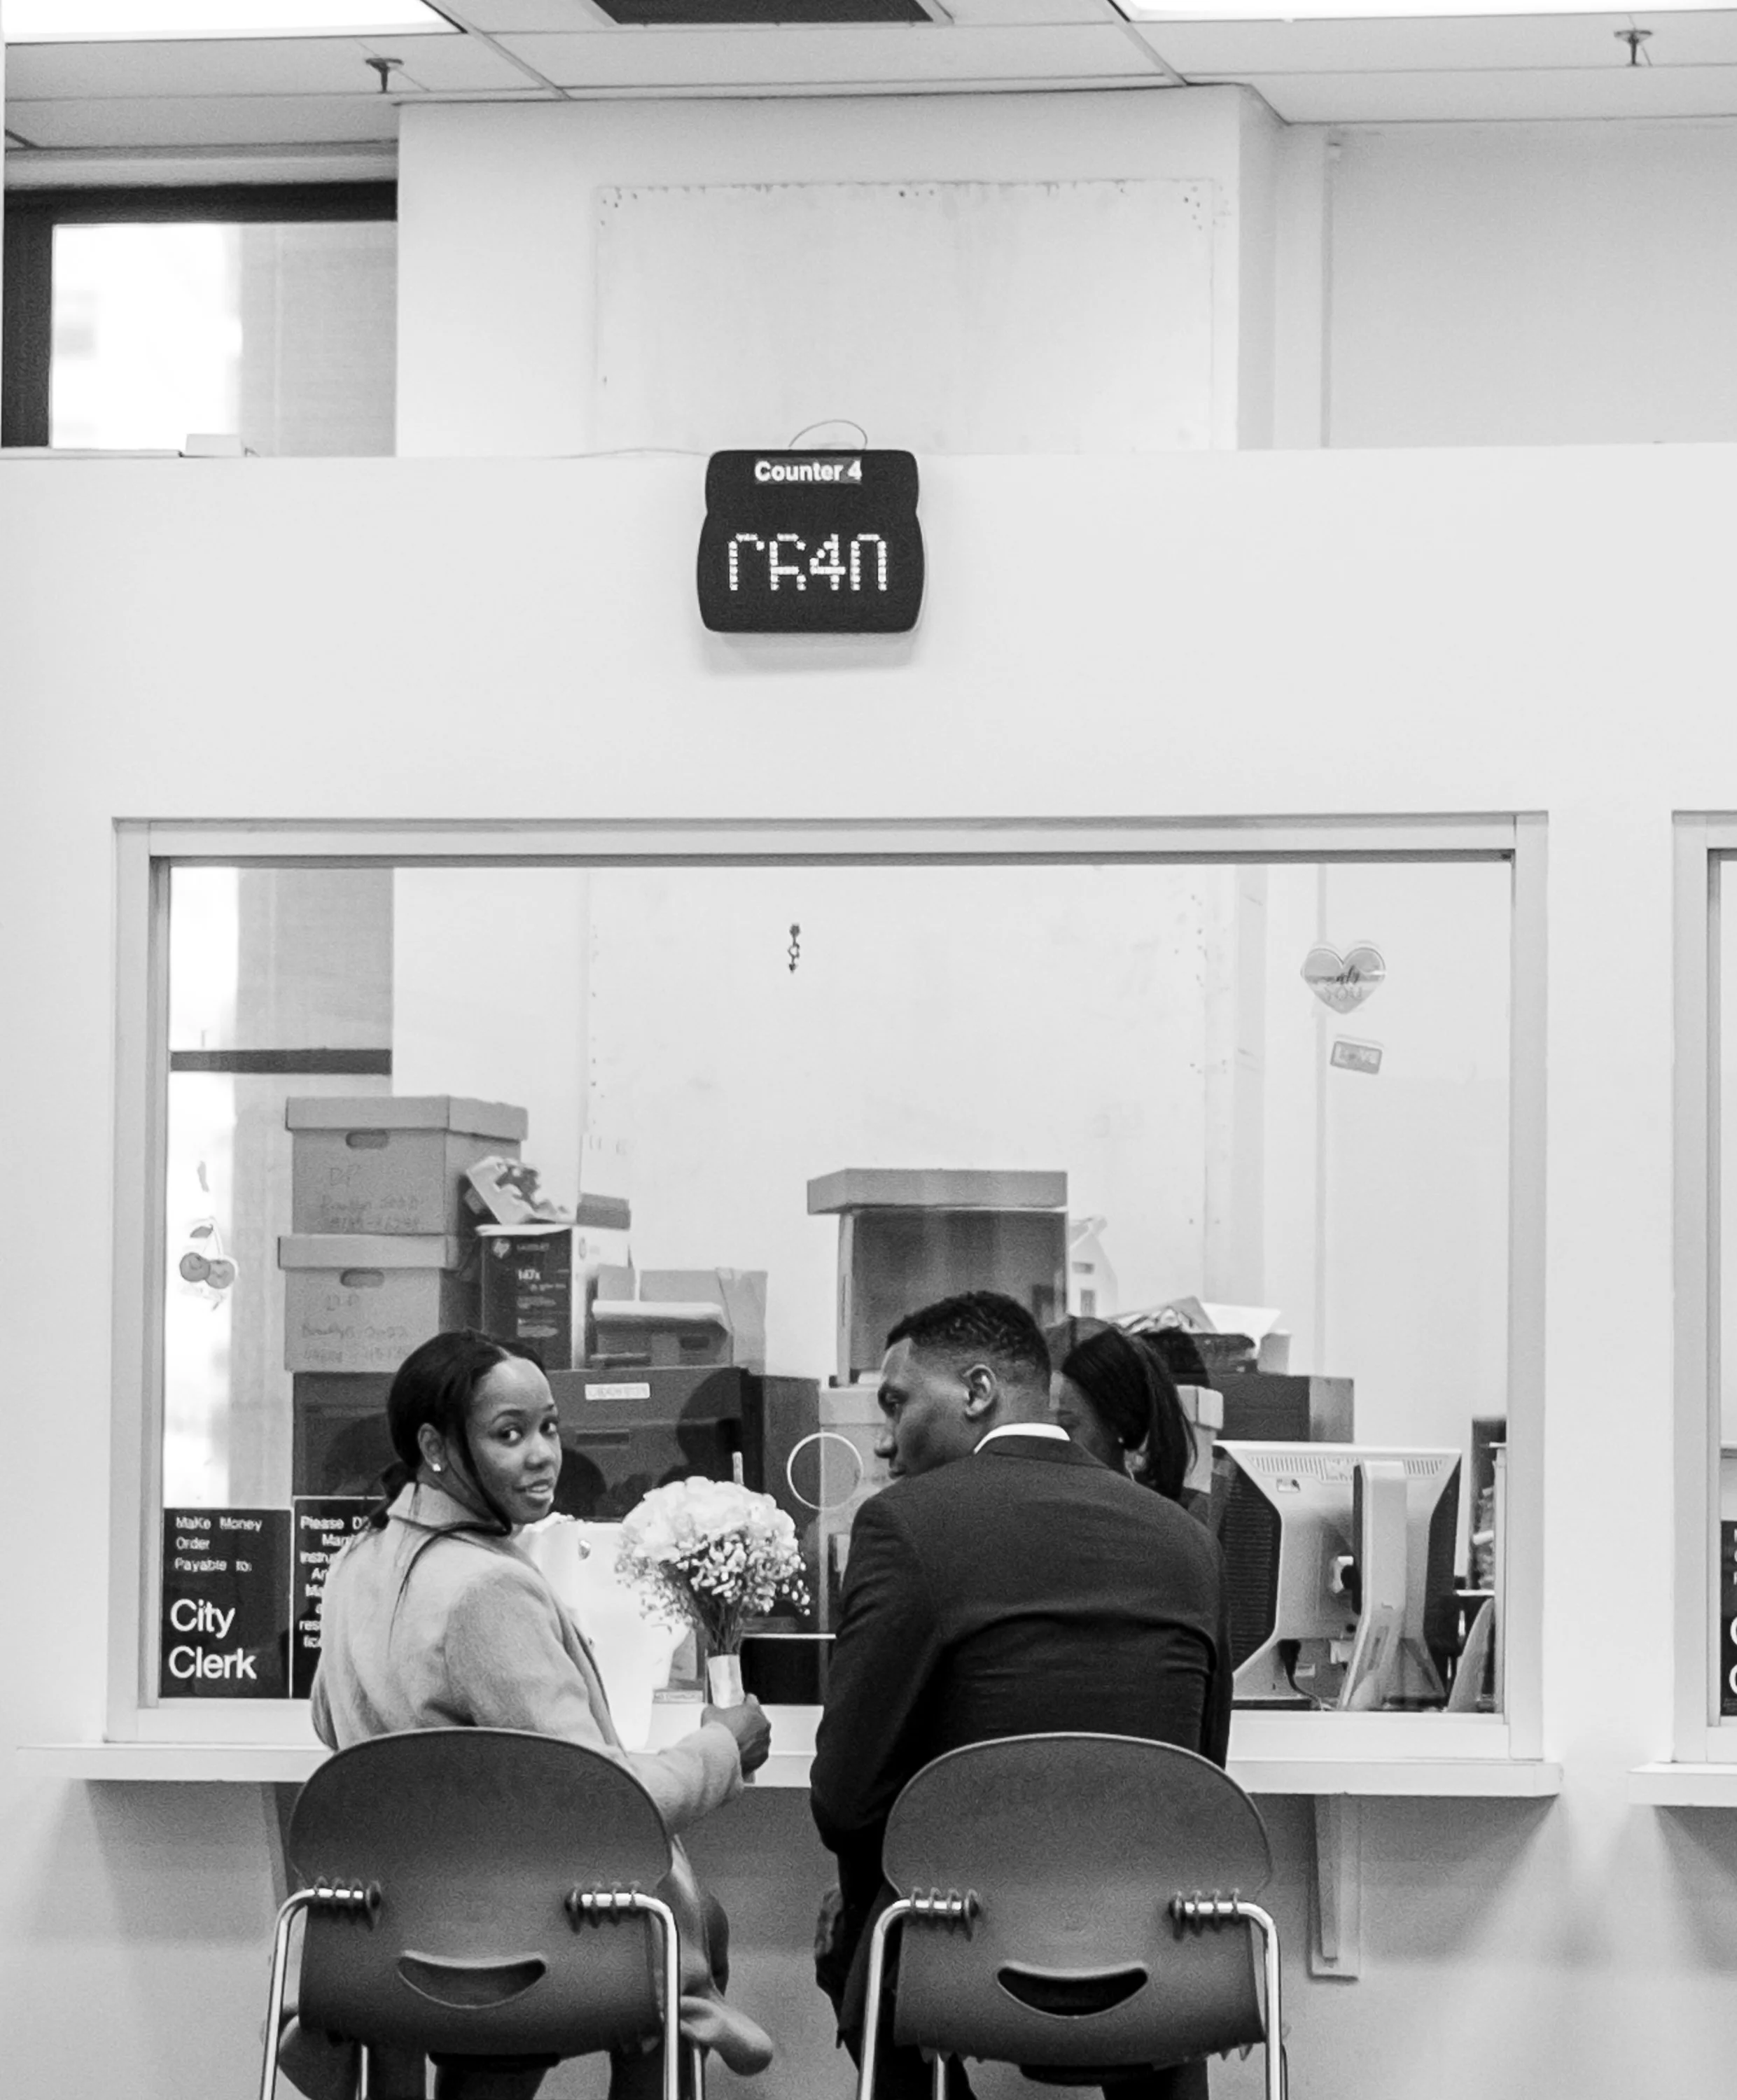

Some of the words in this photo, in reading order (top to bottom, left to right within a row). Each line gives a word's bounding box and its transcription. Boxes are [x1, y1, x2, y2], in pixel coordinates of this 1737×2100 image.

[754, 460, 843, 482] Counter
[847, 460, 863, 480] 4
[220, 1516, 263, 1532] Money
[300, 1516, 344, 1530] Please
[176, 1536, 211, 1550] Order
[174, 1557, 227, 1572] Payable
[170, 1599, 236, 1639] City
[169, 1645, 258, 1679] Clerk
